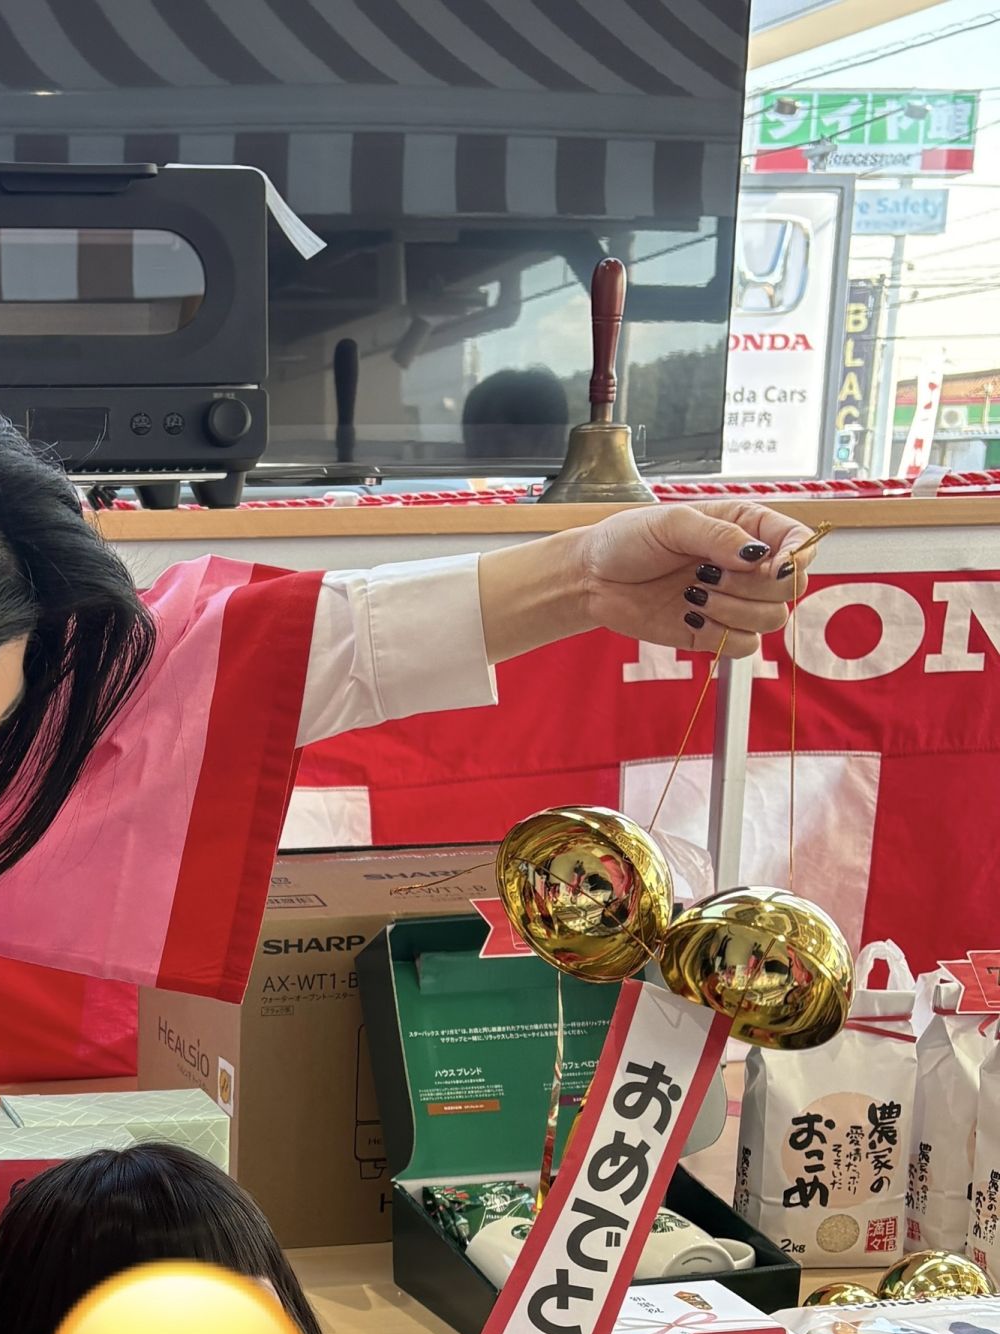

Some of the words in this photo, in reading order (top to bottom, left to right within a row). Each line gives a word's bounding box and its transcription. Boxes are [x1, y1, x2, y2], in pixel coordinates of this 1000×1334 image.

[765, 97, 972, 141] タイヤ館
[827, 151, 913, 168] RIDGESTONE
[877, 197, 941, 217] Safety
[729, 333, 814, 351] ONDA
[835, 302, 868, 430] BLAC
[764, 386, 807, 403] Cars
[728, 439, 777, 452] 山中央店
[363, 868, 472, 880] SHARP
[262, 935, 366, 955] SHARP
[262, 971, 359, 993] AX-WT1-B
[158, 1016, 210, 1078] HEALSIO
[866, 1101, 902, 1193] 農家の
[782, 1112, 836, 1208] おこめ
